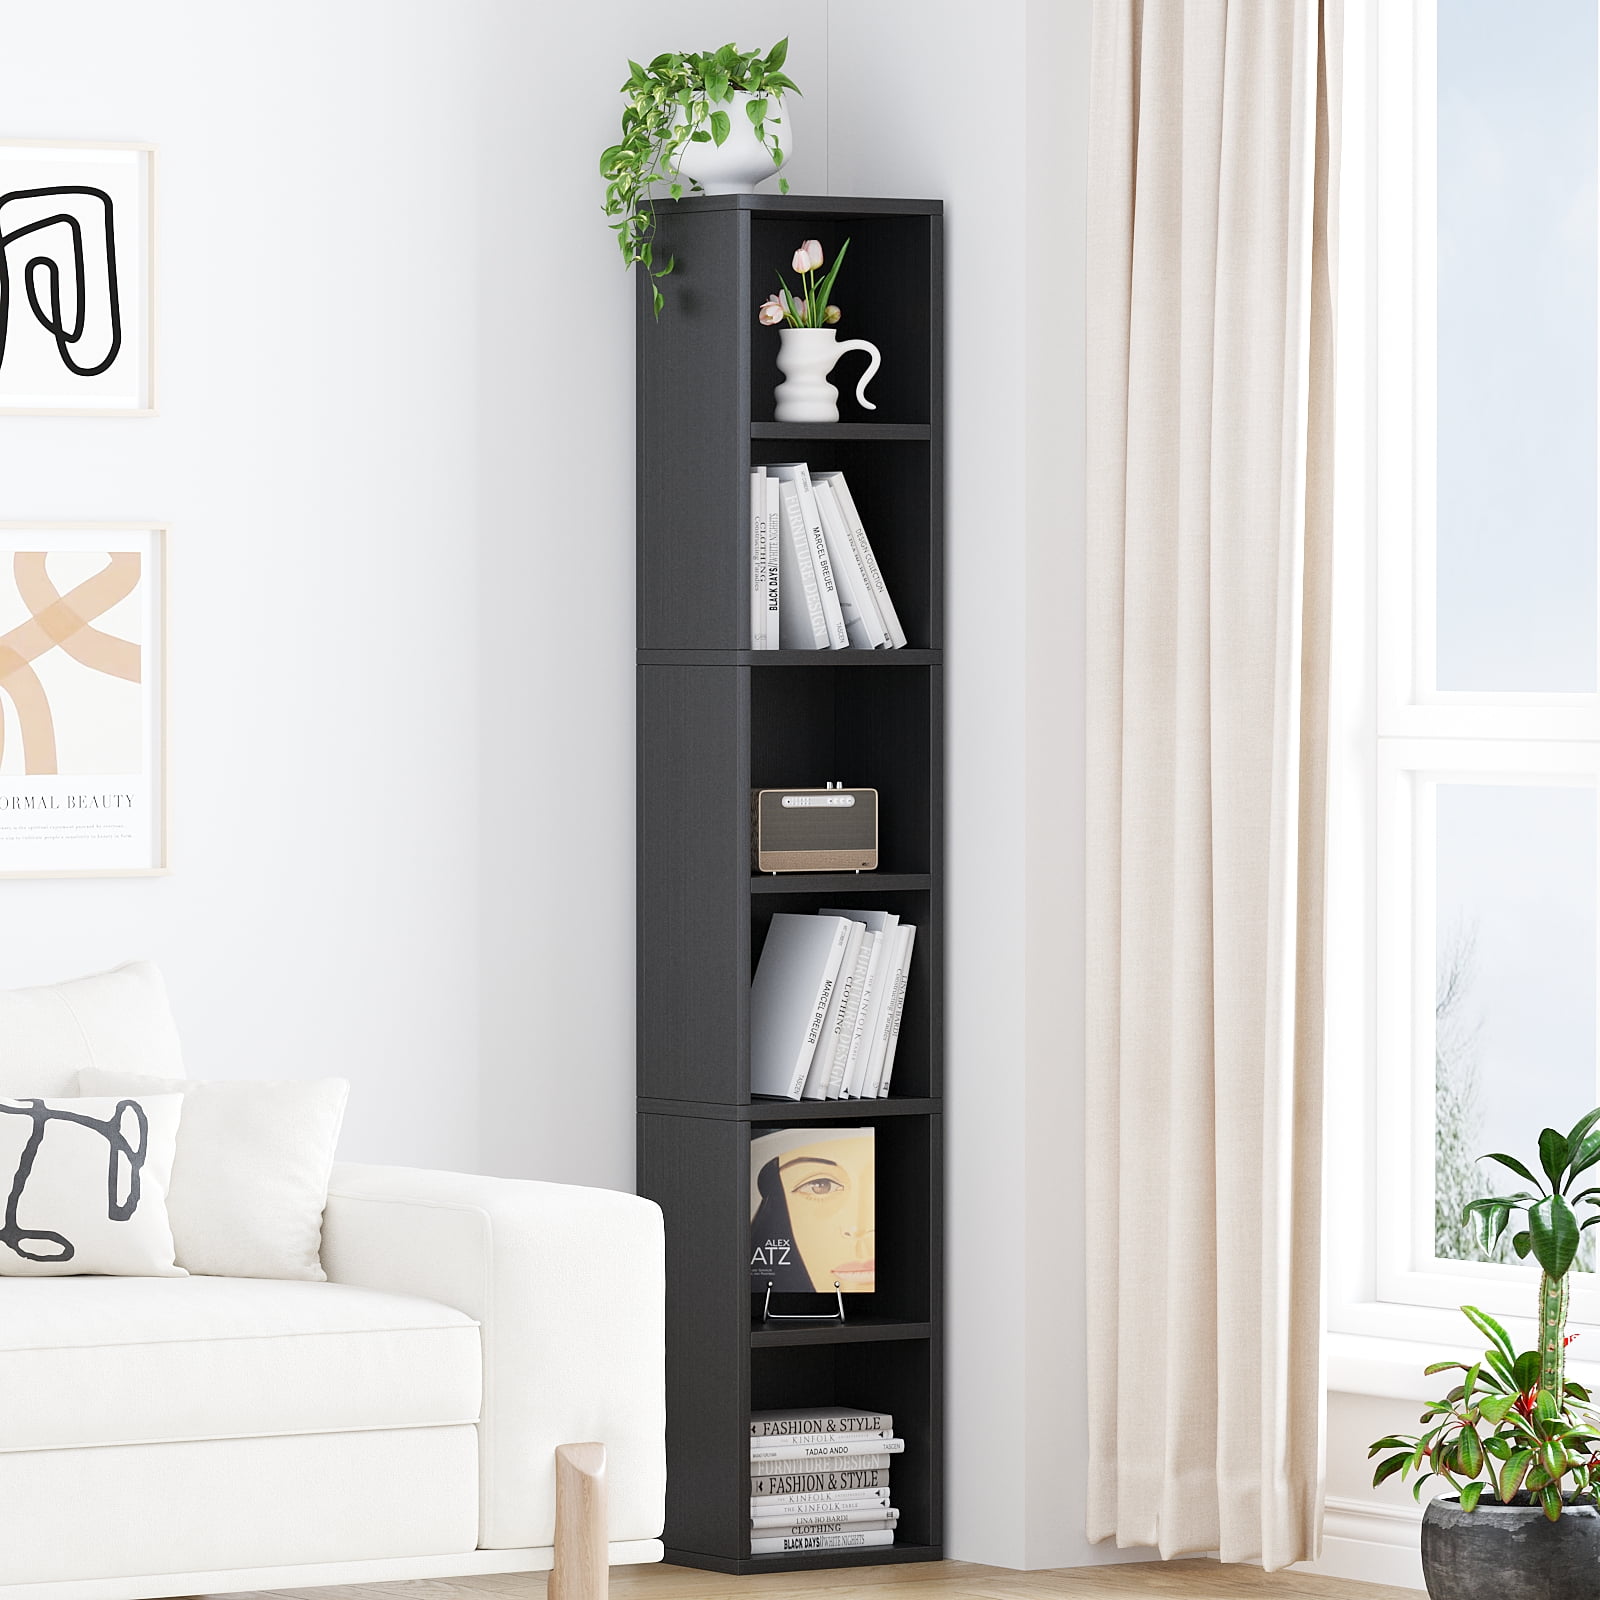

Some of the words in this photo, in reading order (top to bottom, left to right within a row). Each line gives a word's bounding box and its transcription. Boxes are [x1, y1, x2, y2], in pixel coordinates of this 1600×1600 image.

[785, 495, 816, 581] FURNITURE
[804, 584, 827, 637] DESIGN
[813, 526, 826, 559] MARCEL
[820, 560, 834, 593] BREUER
[856, 528, 869, 553] DESIGN
[866, 553, 885, 593] COLLECTION
[769, 587, 778, 611] BLACK
[67, 794, 134, 809] BEAUTY
[817, 979, 832, 1010] MARCEL
[840, 945, 872, 1031] FURNITURE
[835, 976, 853, 1034] CLOTHING
[854, 990, 871, 1040] KINFOLK
[807, 1012, 823, 1044] BREUER
[830, 1035, 851, 1087] DESIGN
[764, 1239, 790, 1247] ALEX
[763, 1420, 822, 1436] FASHION
[826, 1419, 836, 1432] &
[840, 1417, 881, 1431] STYLE
[792, 1434, 836, 1444] KINFOLK
[805, 1447, 829, 1456] TADAO
[829, 1446, 849, 1454] ANDO
[757, 1457, 832, 1475] FURNITURE
[834, 1454, 879, 1472] DESIGN
[769, 1474, 824, 1494] FASHION
[828, 1473, 837, 1490] &
[840, 1470, 878, 1489] STYLE
[789, 1492, 833, 1503] KINFOLK
[797, 1502, 841, 1513] KINFOLK
[791, 1523, 842, 1535] CLOTHING
[796, 1517, 813, 1525] LINA
[826, 1514, 849, 1523] BARDI
[783, 1538, 803, 1550] BLACK
